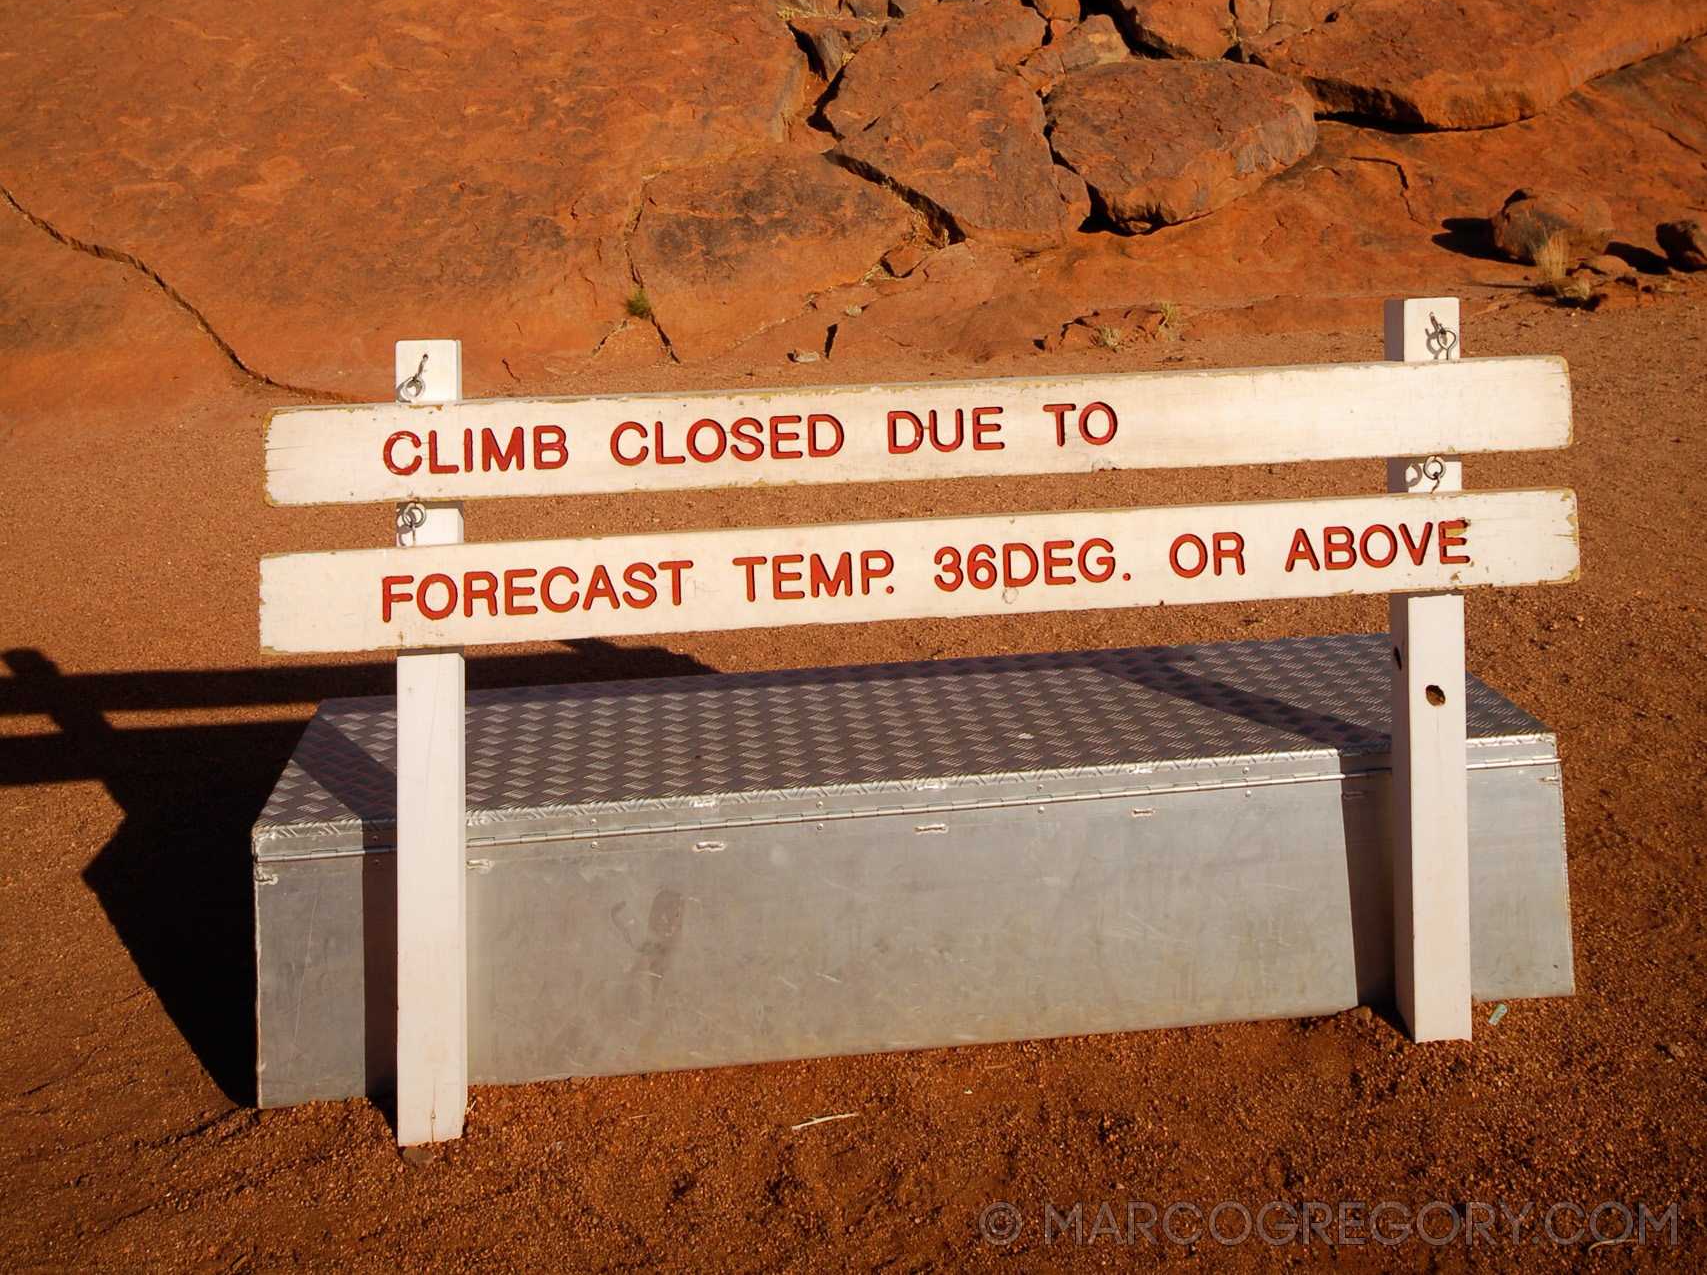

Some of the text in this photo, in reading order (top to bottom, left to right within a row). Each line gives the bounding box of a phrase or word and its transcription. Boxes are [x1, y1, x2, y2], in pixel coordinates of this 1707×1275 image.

[382, 401, 1120, 477] CLIMB CLOSED DUE TO
[381, 517, 1472, 624] FORECAST TEMP. 36DEG. OR ABOVE
